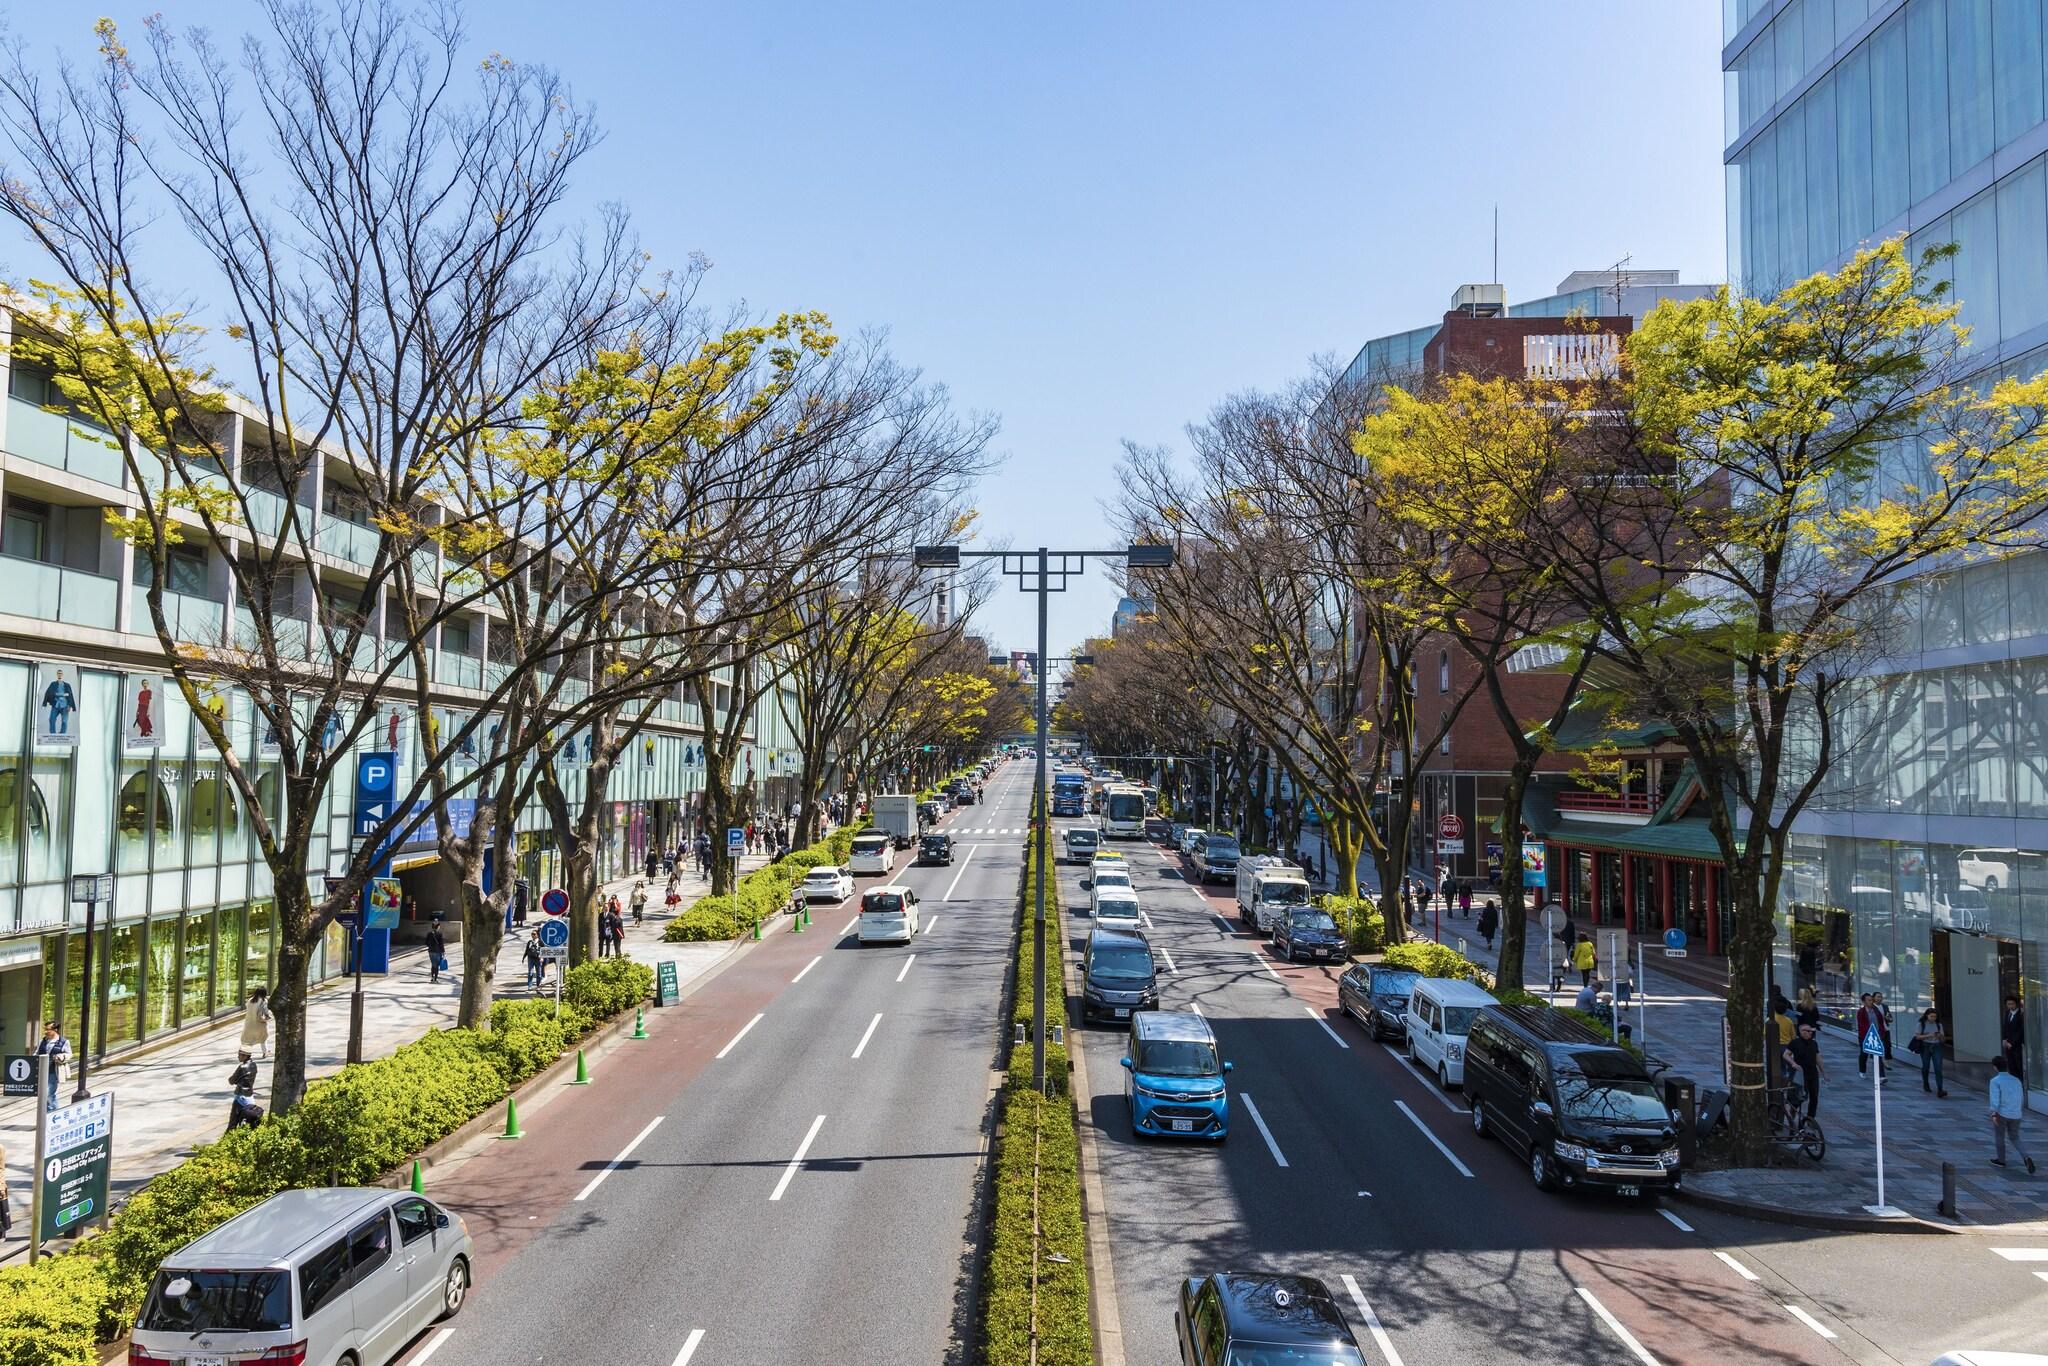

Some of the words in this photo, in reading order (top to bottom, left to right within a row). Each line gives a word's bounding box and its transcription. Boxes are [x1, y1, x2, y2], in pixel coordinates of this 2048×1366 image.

[367, 766, 386, 784] P
[729, 830, 743, 845] P
[1960, 908, 1991, 933] Dior
[546, 927, 558, 945] P
[553, 936, 563, 945] 60
